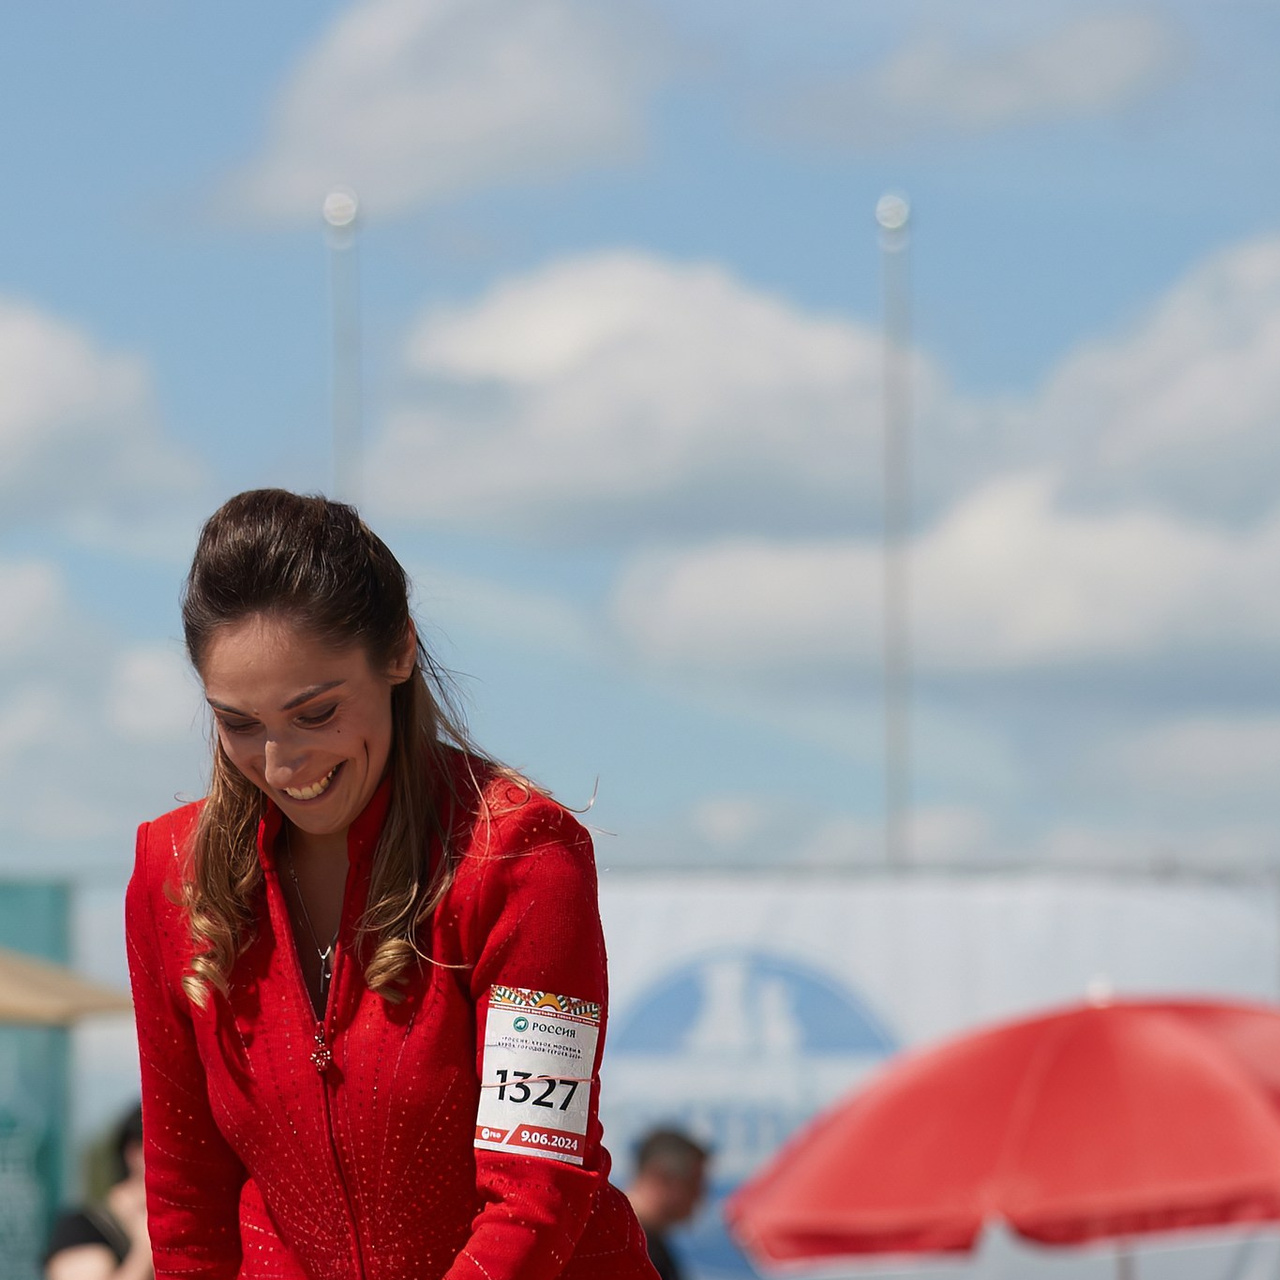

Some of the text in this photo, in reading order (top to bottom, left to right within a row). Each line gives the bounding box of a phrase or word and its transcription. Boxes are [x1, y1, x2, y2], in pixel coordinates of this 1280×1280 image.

[532, 1022, 576, 1038] РОССИЯ
[496, 1068, 579, 1111] 1327
[520, 1130, 578, 1150] 9.06.2024
